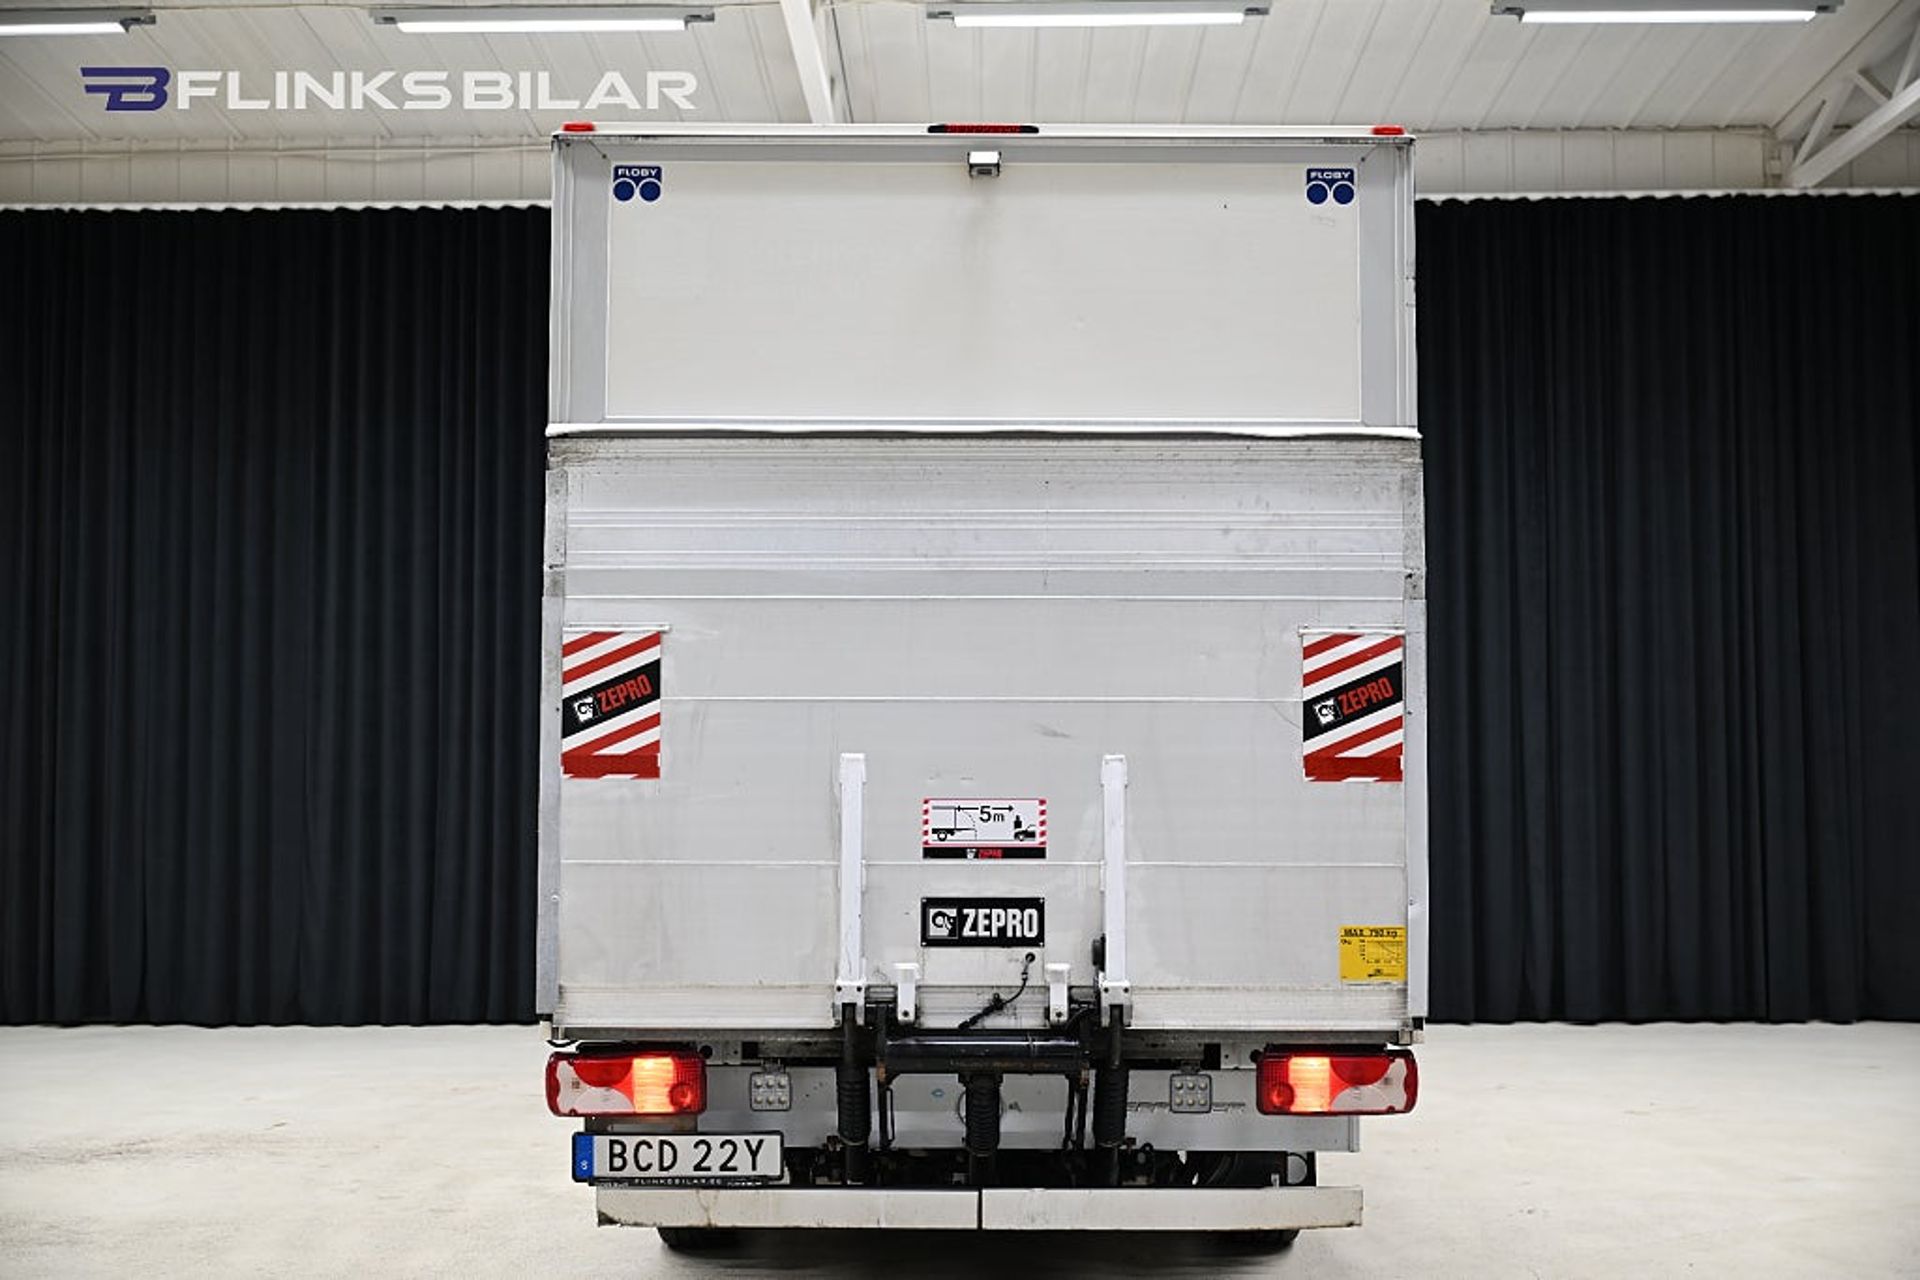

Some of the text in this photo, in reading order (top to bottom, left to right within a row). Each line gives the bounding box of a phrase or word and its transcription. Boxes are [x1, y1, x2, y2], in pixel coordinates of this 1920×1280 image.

[617, 168, 658, 177] FLOBY
[597, 674, 652, 713] ZEPRO
[1338, 677, 1394, 716] ZEPRO
[962, 908, 1039, 938] ZEPRO
[608, 1139, 764, 1172] BCD 22Y
